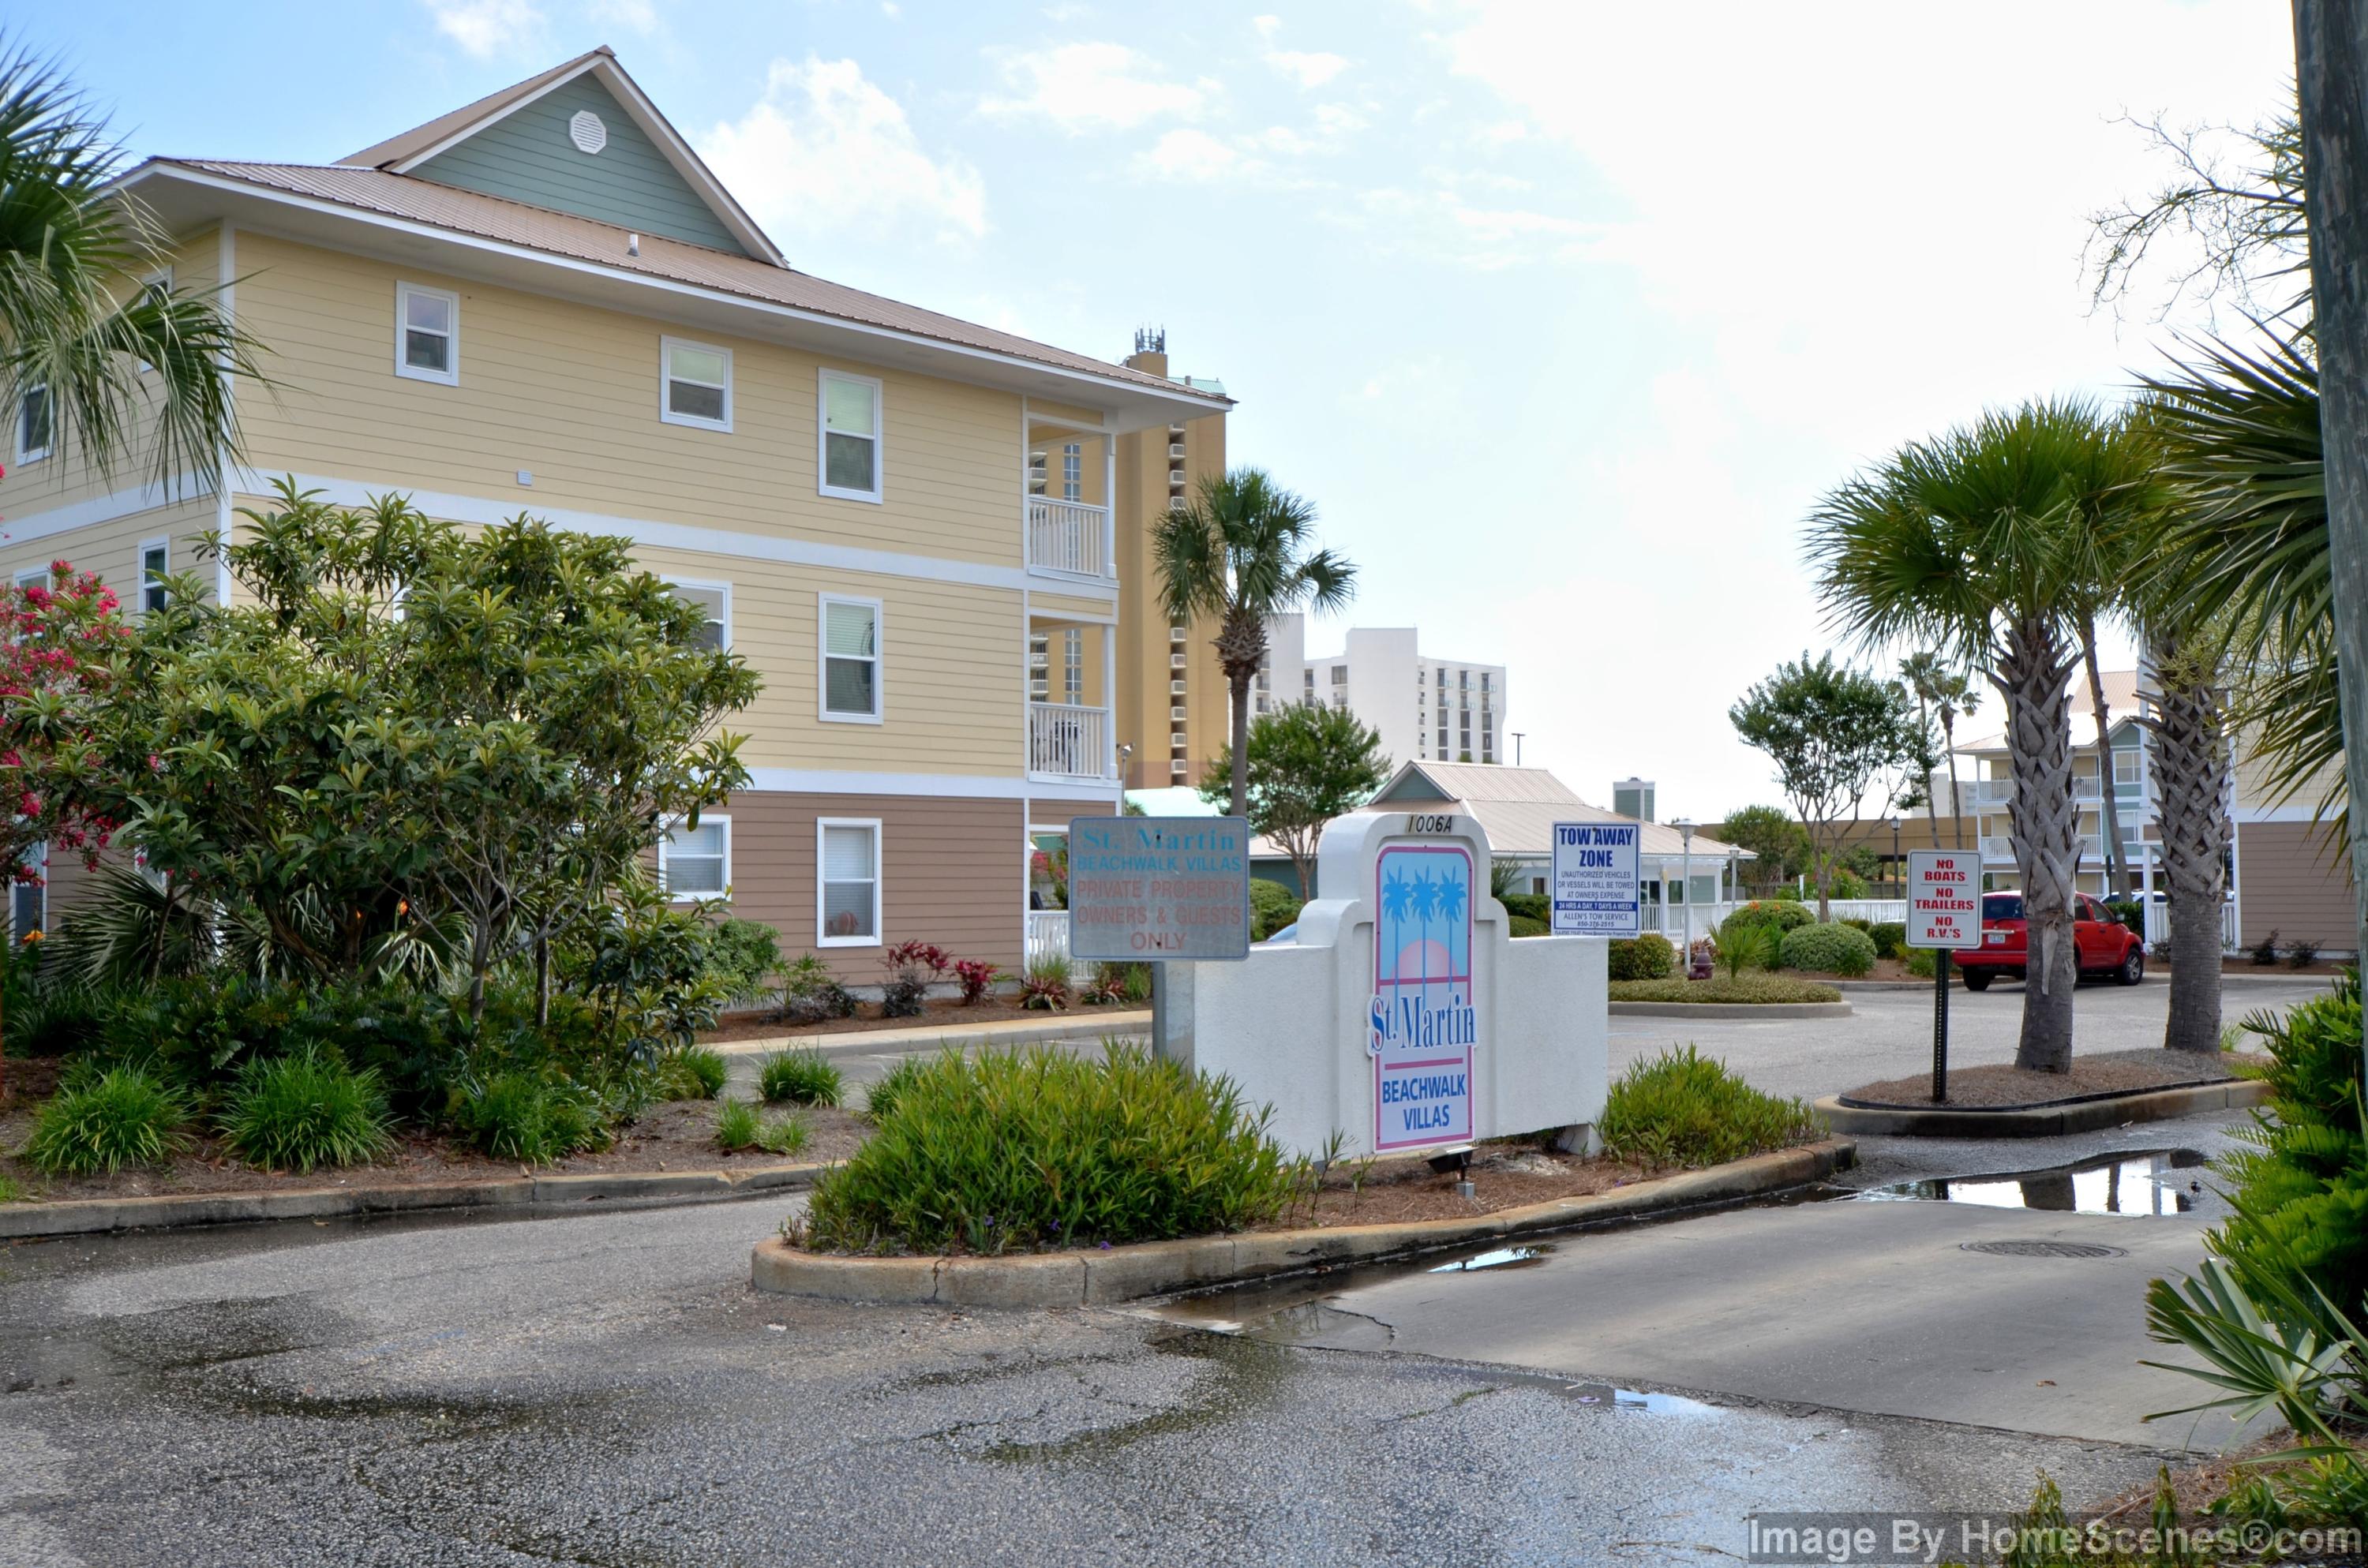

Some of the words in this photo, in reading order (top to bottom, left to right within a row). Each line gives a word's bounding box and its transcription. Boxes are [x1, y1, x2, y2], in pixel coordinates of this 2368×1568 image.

[1408, 816, 1452, 833] 1006A
[1081, 829, 1119, 850] St.
[1137, 829, 1235, 850] Martin
[1559, 828, 1591, 845] TOW
[1594, 828, 1633, 845] AWAY
[1077, 855, 1176, 871] BEACHWALK
[1186, 855, 1241, 871] VILLAS
[1579, 850, 1613, 867] ZONE
[1936, 859, 1954, 869] NO
[1924, 870, 1965, 881] BOATS
[1077, 881, 1141, 898] PRIVATE
[1152, 881, 1241, 899] PROPERTY
[1935, 888, 1953, 897] NO
[1915, 899, 1974, 910] TRAILERS
[1077, 907, 1147, 924] OWNERS
[1156, 907, 1167, 924] &
[1176, 907, 1241, 925] GUESTS
[1935, 916, 1952, 926] NO
[1130, 932, 1187, 950] ONLY
[1927, 928, 1961, 938] R.V.'S
[1371, 997, 1396, 1051] St.
[1400, 994, 1475, 1048] Martin
[1382, 1074, 1466, 1103] BEACHWALK
[1403, 1105, 1449, 1130] VILLAS
